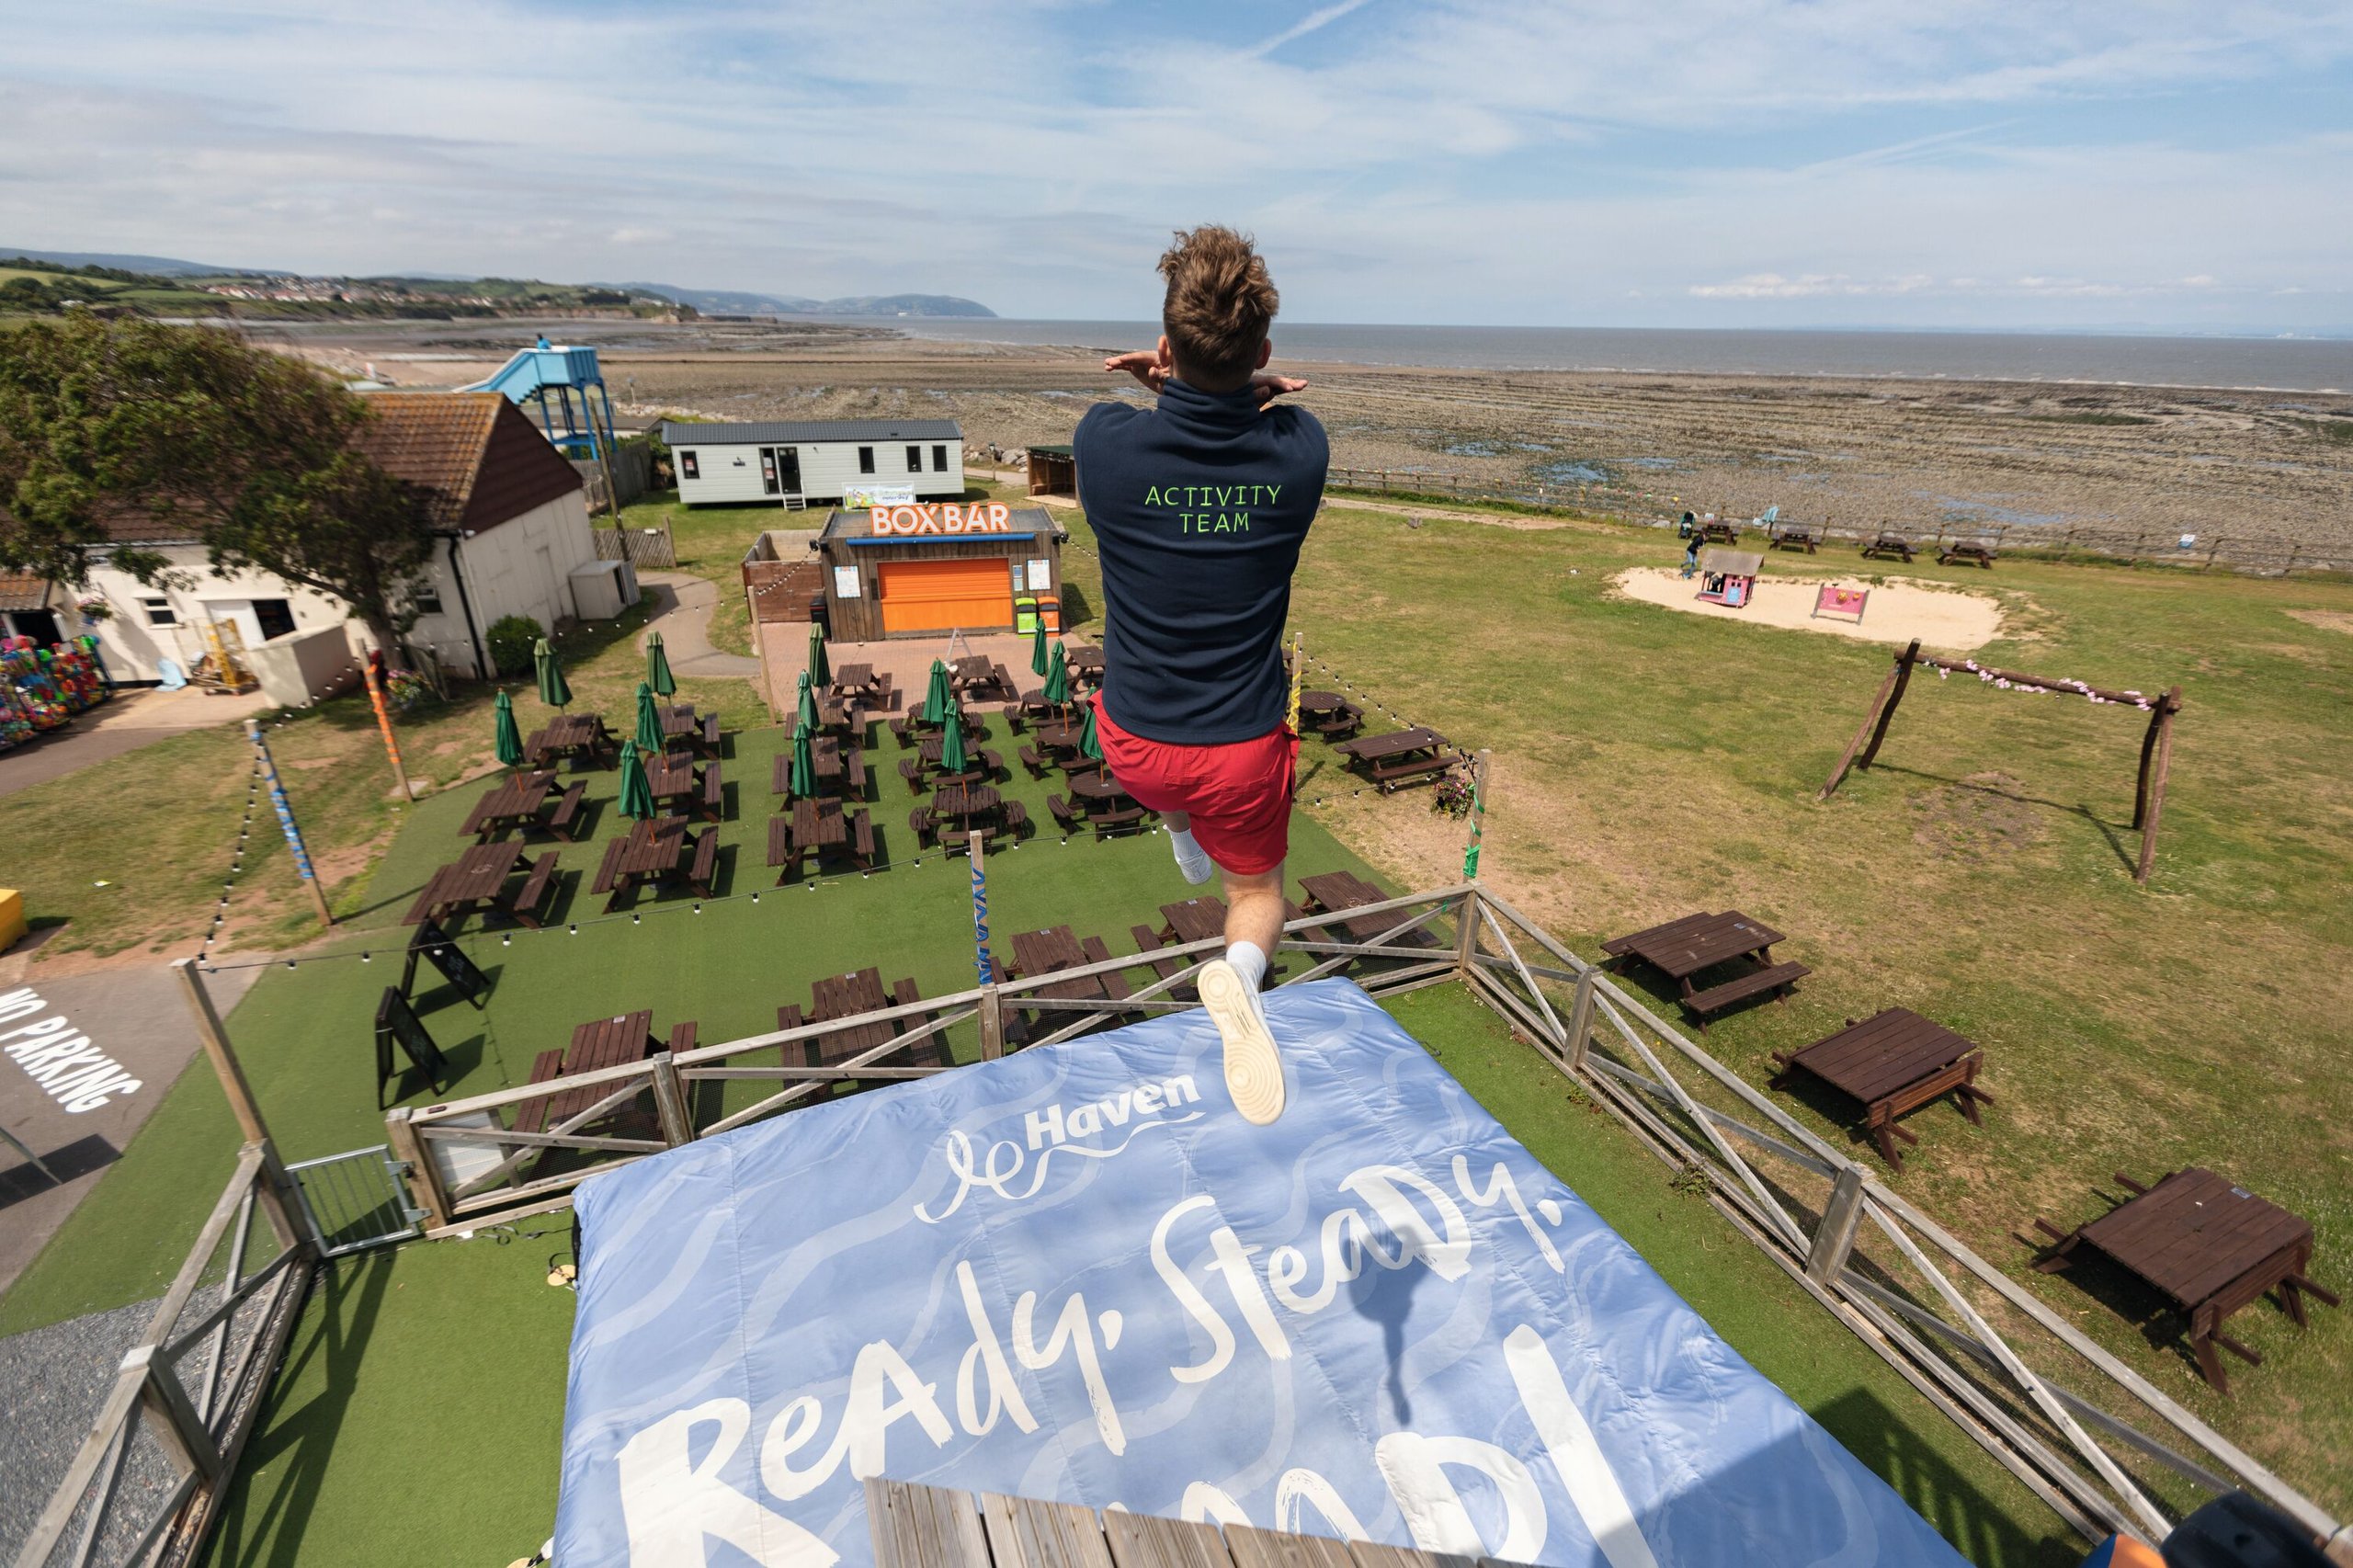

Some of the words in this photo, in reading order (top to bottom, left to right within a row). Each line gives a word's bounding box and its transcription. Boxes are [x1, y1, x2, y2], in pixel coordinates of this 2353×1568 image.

[1144, 484, 1282, 507] ACTIVITY
[1178, 512, 1250, 533] TEAM
[0, 1016, 144, 1113] PARKING
[1024, 1074, 1202, 1152] Haven
